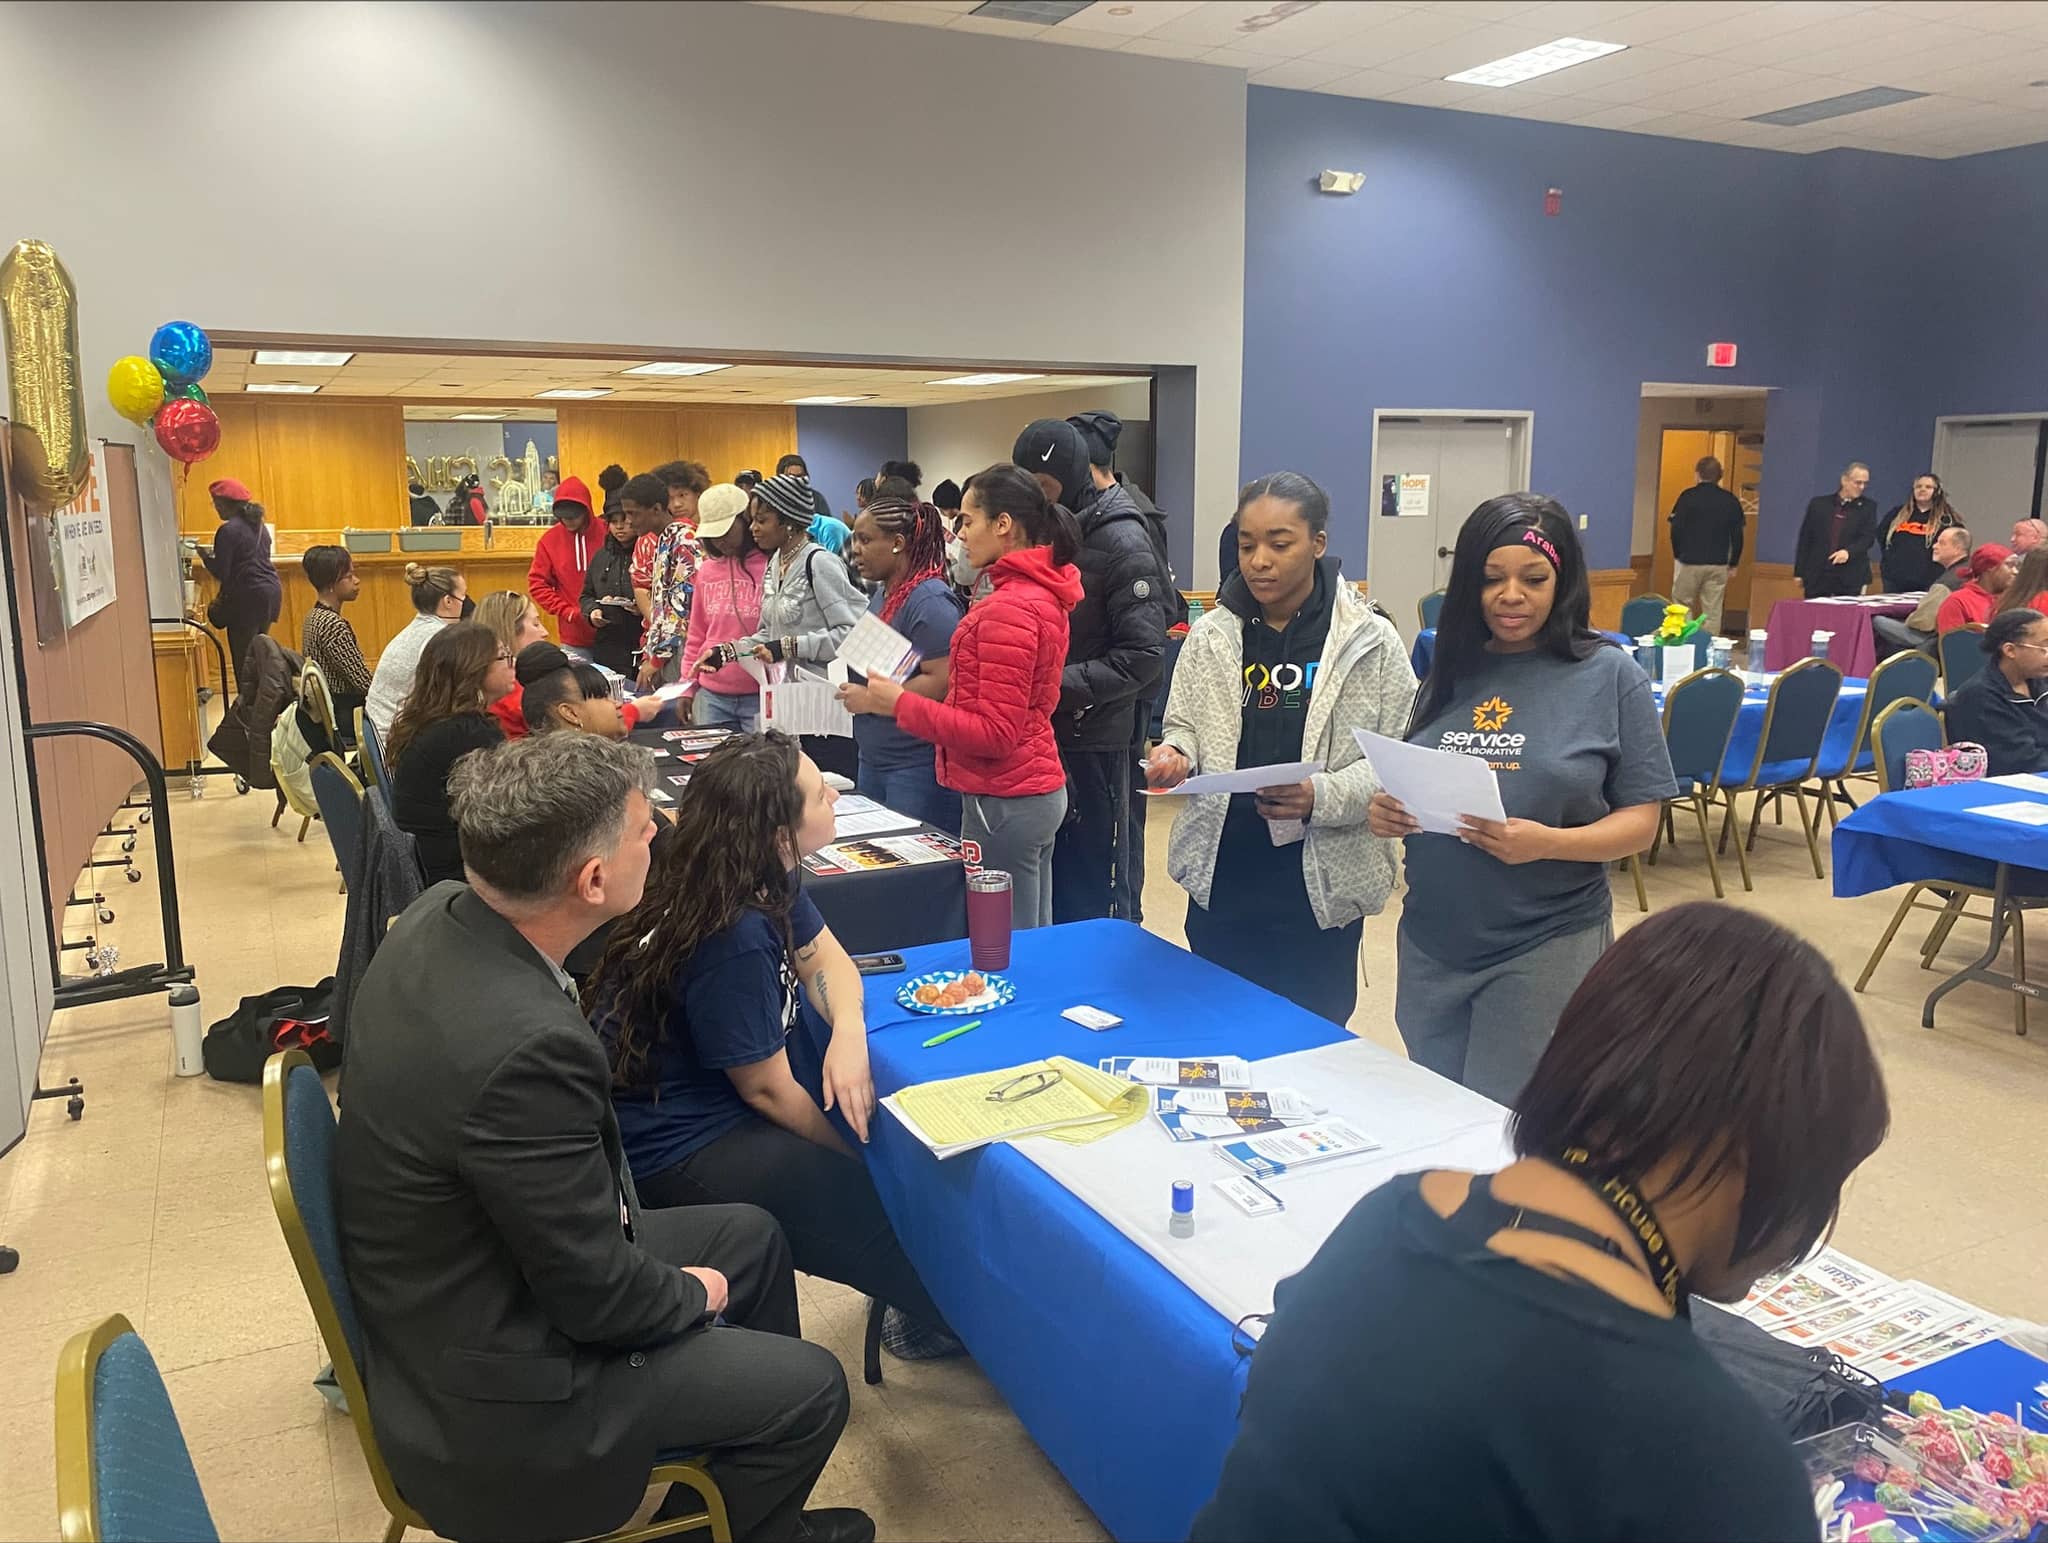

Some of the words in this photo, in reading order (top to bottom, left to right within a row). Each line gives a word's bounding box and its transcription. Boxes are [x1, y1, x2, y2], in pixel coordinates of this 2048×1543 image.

[1402, 479, 1426, 488] HOPE
[1440, 731, 1526, 748] service
[1438, 745, 1522, 756] COLLABORATIVE
